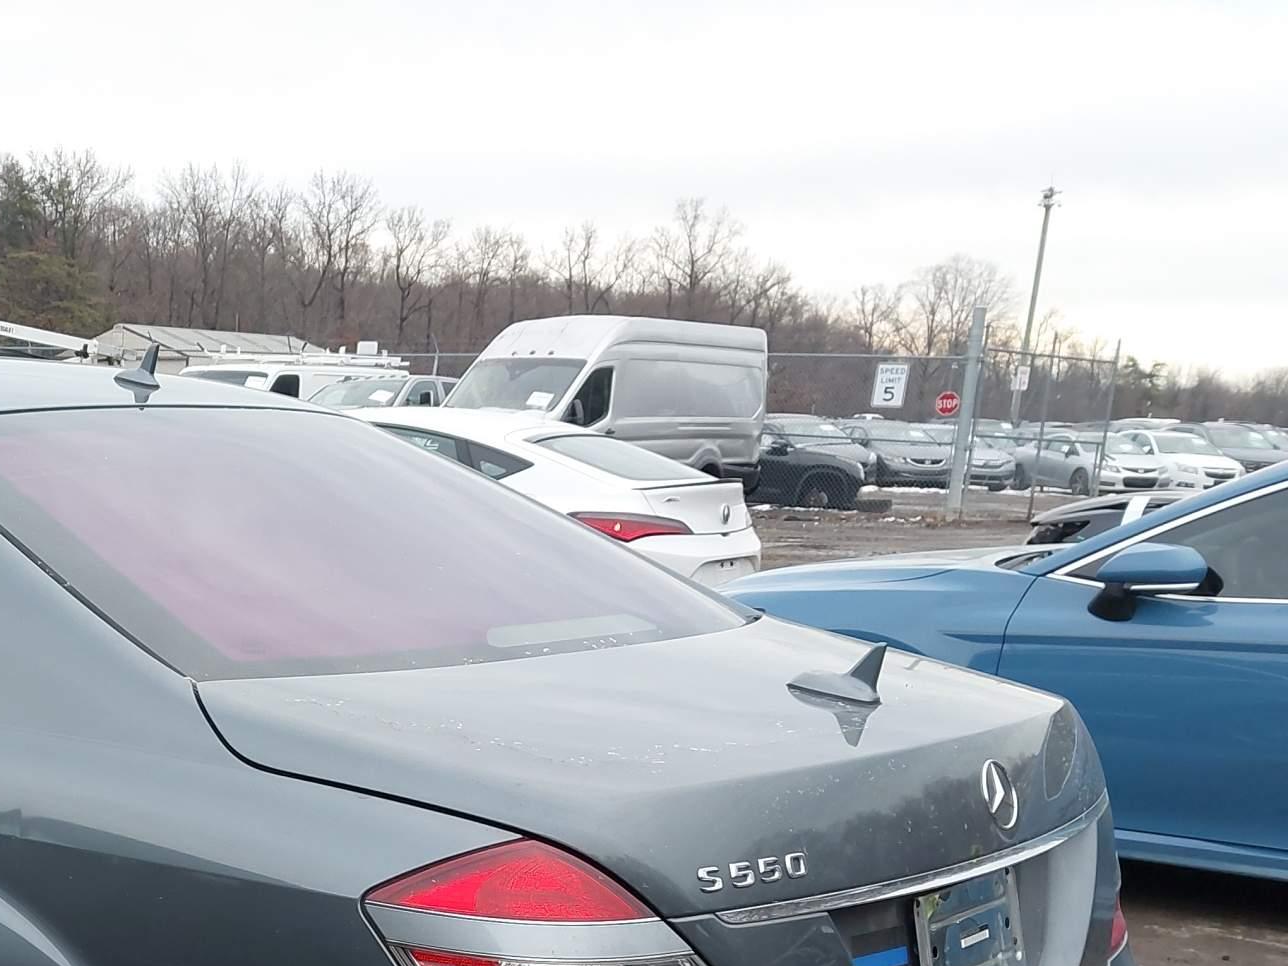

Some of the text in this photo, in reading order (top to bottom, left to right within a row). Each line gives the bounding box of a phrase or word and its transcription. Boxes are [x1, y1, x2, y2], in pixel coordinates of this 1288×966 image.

[879, 367, 906, 375] SPEED
[880, 376, 902, 384] LIMIT
[882, 386, 895, 402] 5
[937, 398, 958, 409] STOP
